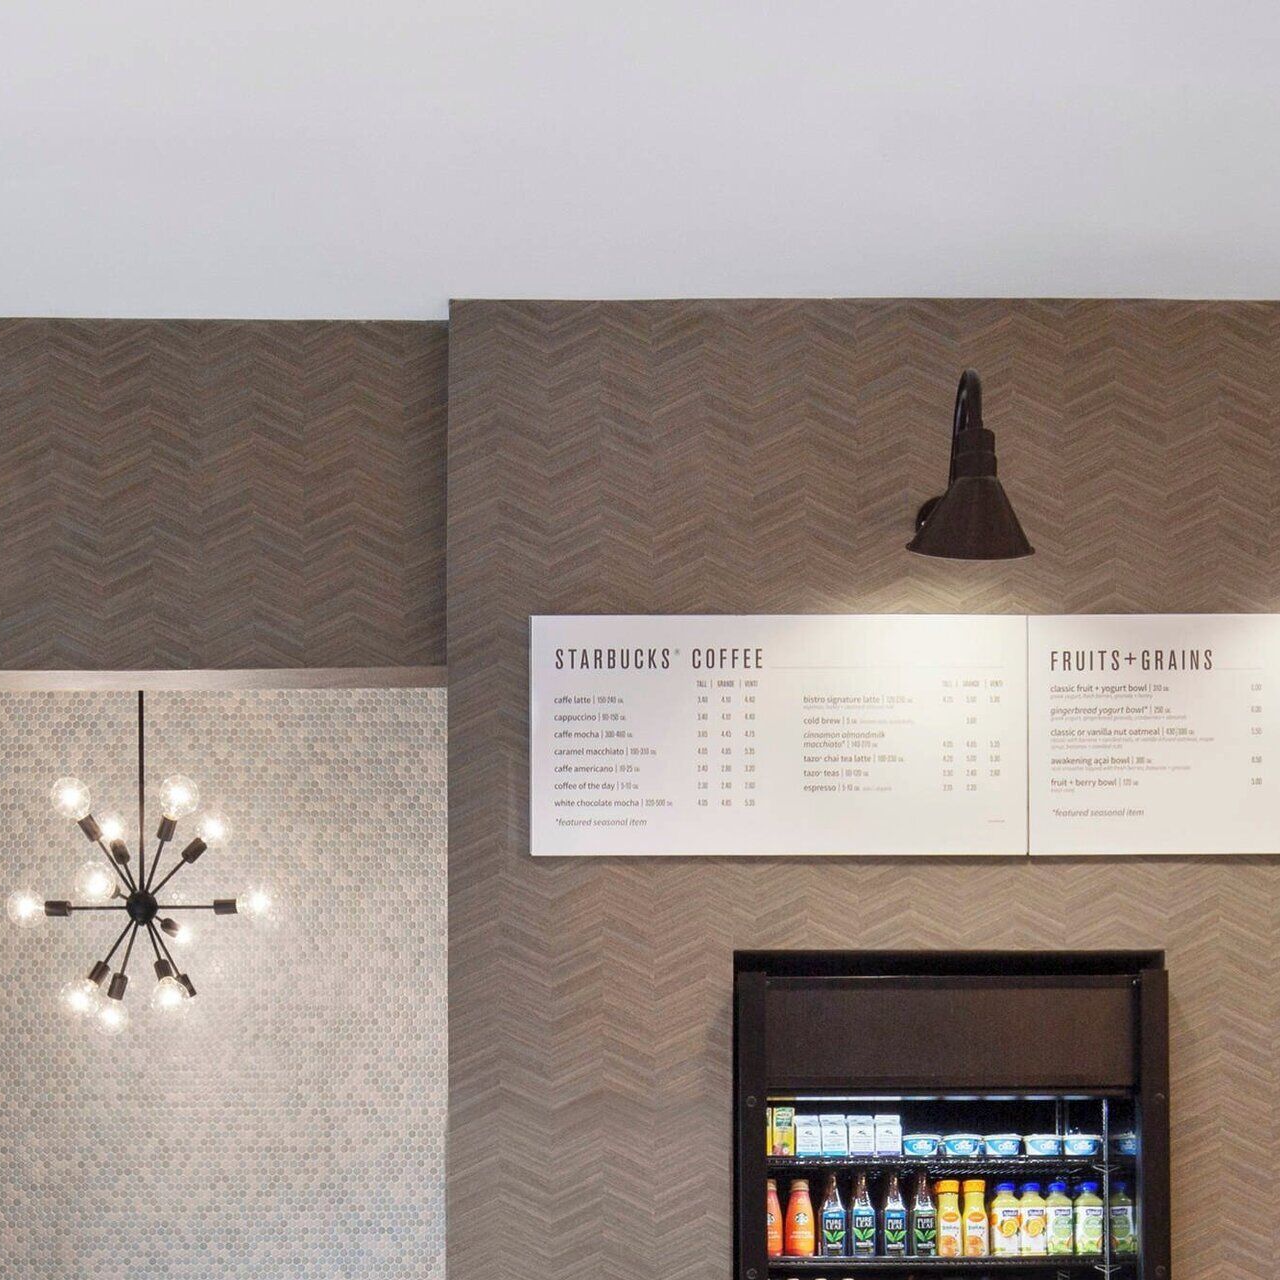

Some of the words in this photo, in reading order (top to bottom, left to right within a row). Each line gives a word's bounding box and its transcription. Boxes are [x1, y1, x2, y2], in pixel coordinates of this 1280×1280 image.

[692, 648, 763, 670] COFFEE
[1051, 649, 1213, 671] FRUITS+GRAINS
[1050, 684, 1075, 692] classic
[1076, 684, 1093, 692] fruit
[1101, 685, 1127, 694] yogurt
[1128, 684, 1147, 692] bowl
[574, 696, 591, 704] latte
[803, 696, 826, 704] bistro
[827, 696, 862, 705] signature
[863, 696, 880, 704] latte
[1050, 706, 1097, 716] gingerbread
[1099, 706, 1124, 716] yogurt
[554, 713, 597, 722] cappuccino
[574, 730, 599, 738] mocha
[803, 731, 840, 739] cinnamon
[842, 731, 885, 739] almondmilk
[1050, 728, 1075, 736] classic
[1087, 728, 1112, 736] vanilla
[1114, 728, 1127, 736] nut
[1128, 728, 1160, 736] oatmeal
[554, 748, 584, 756] caramel
[586, 748, 624, 756] macchiato
[824, 755, 840, 763] chai
[841, 755, 852, 763] tea
[854, 755, 871, 763] latte
[1051, 756, 1092, 766] awakening
[1111, 756, 1130, 764] bowl
[574, 765, 614, 773] americano
[554, 782, 577, 790] coffee
[578, 782, 587, 790] of
[587, 782, 600, 790] the
[601, 782, 615, 791] day
[1051, 779, 1067, 787] fruit
[1075, 779, 1096, 788] berry
[1098, 779, 1117, 787] bowl
[803, 785, 836, 793] espresso
[554, 799, 575, 807] white
[576, 799, 613, 807] chocolate
[614, 799, 639, 807] mocha
[1090, 809, 1125, 817] seasonal
[1126, 809, 1144, 817] item
[593, 818, 628, 826] seasonal
[629, 818, 647, 826] item
